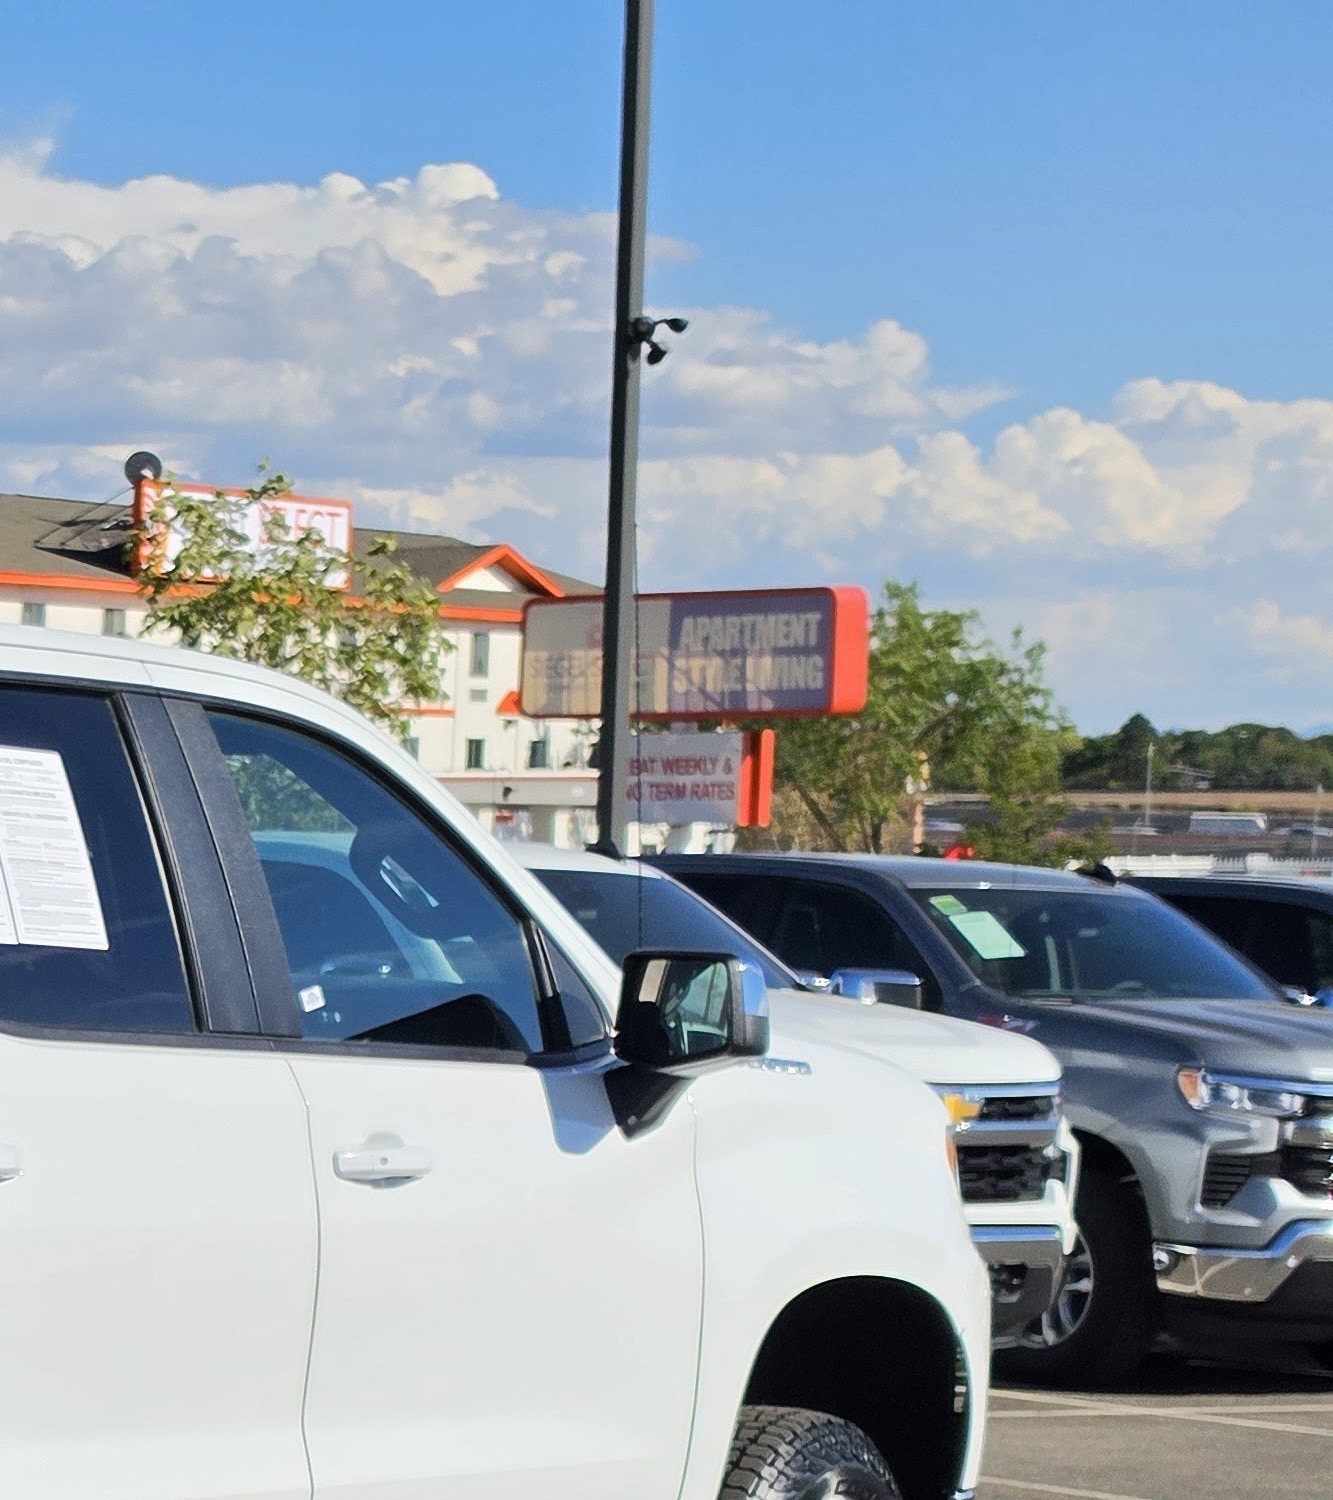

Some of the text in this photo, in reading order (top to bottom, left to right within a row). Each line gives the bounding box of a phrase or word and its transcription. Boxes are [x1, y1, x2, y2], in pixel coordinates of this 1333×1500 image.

[679, 611, 823, 654] APARTMENT
[672, 653, 825, 693] STYLE LIVING
[661, 755, 717, 776] WEEKLY
[648, 781, 687, 801] TERM
[690, 781, 735, 801] RATES
